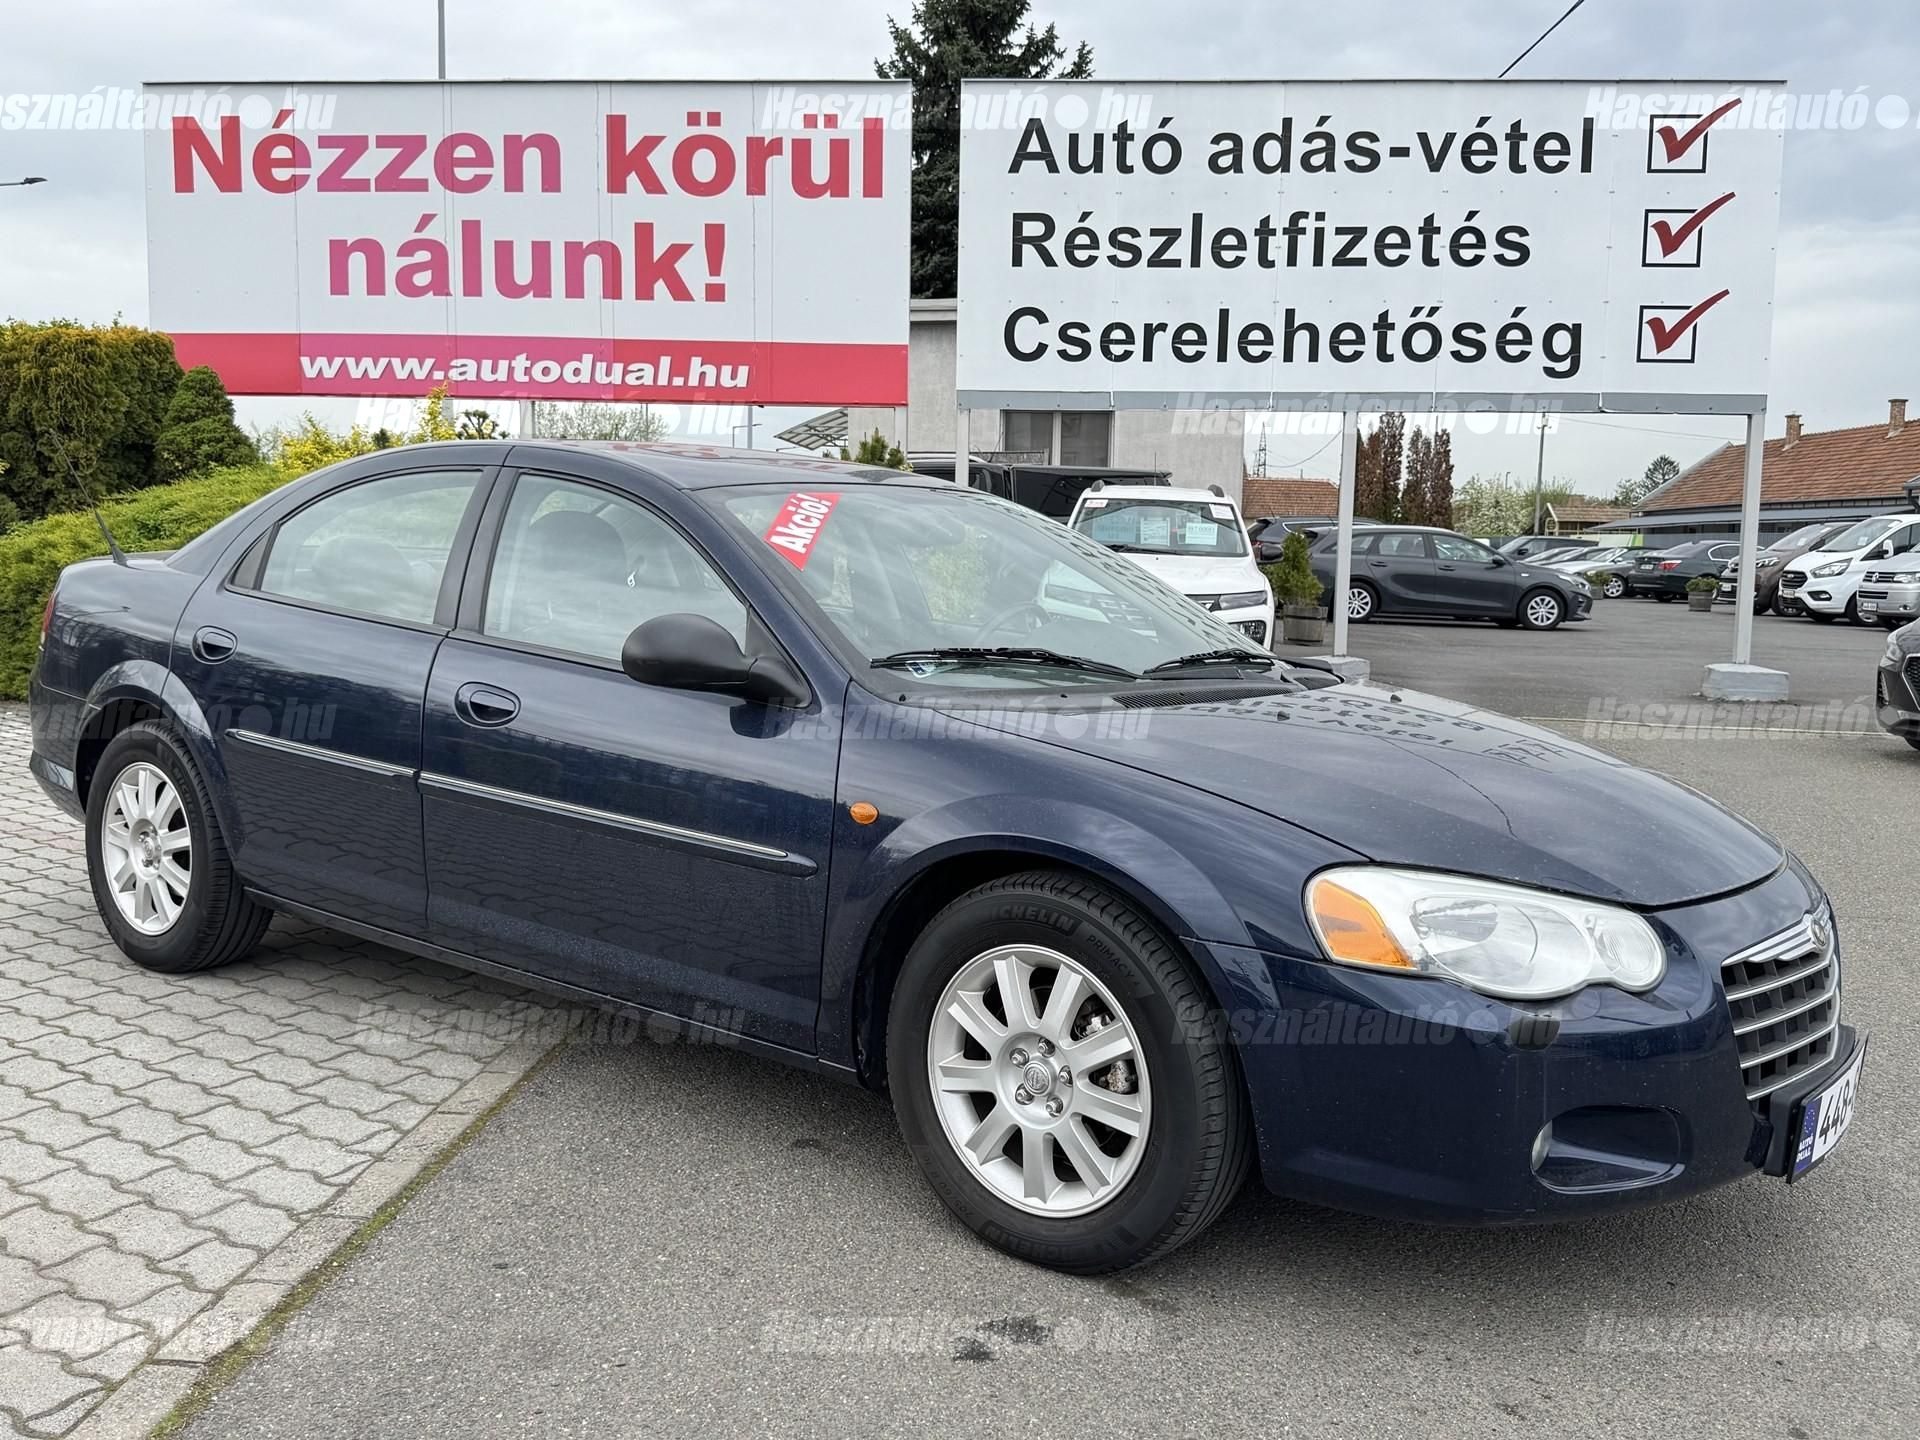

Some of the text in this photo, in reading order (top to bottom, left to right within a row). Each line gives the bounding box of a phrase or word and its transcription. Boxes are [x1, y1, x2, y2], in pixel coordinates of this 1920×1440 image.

[172, 109, 883, 199] Nézzen körül
[1007, 115, 1594, 175] Autó adás-vétel
[329, 214, 725, 302] nálunk!
[1011, 210, 1531, 269] Részletfizetés
[300, 353, 749, 388] www.autodual.hu
[1003, 306, 1582, 379] Cserelehetőség
[769, 492, 833, 555] Akció!
